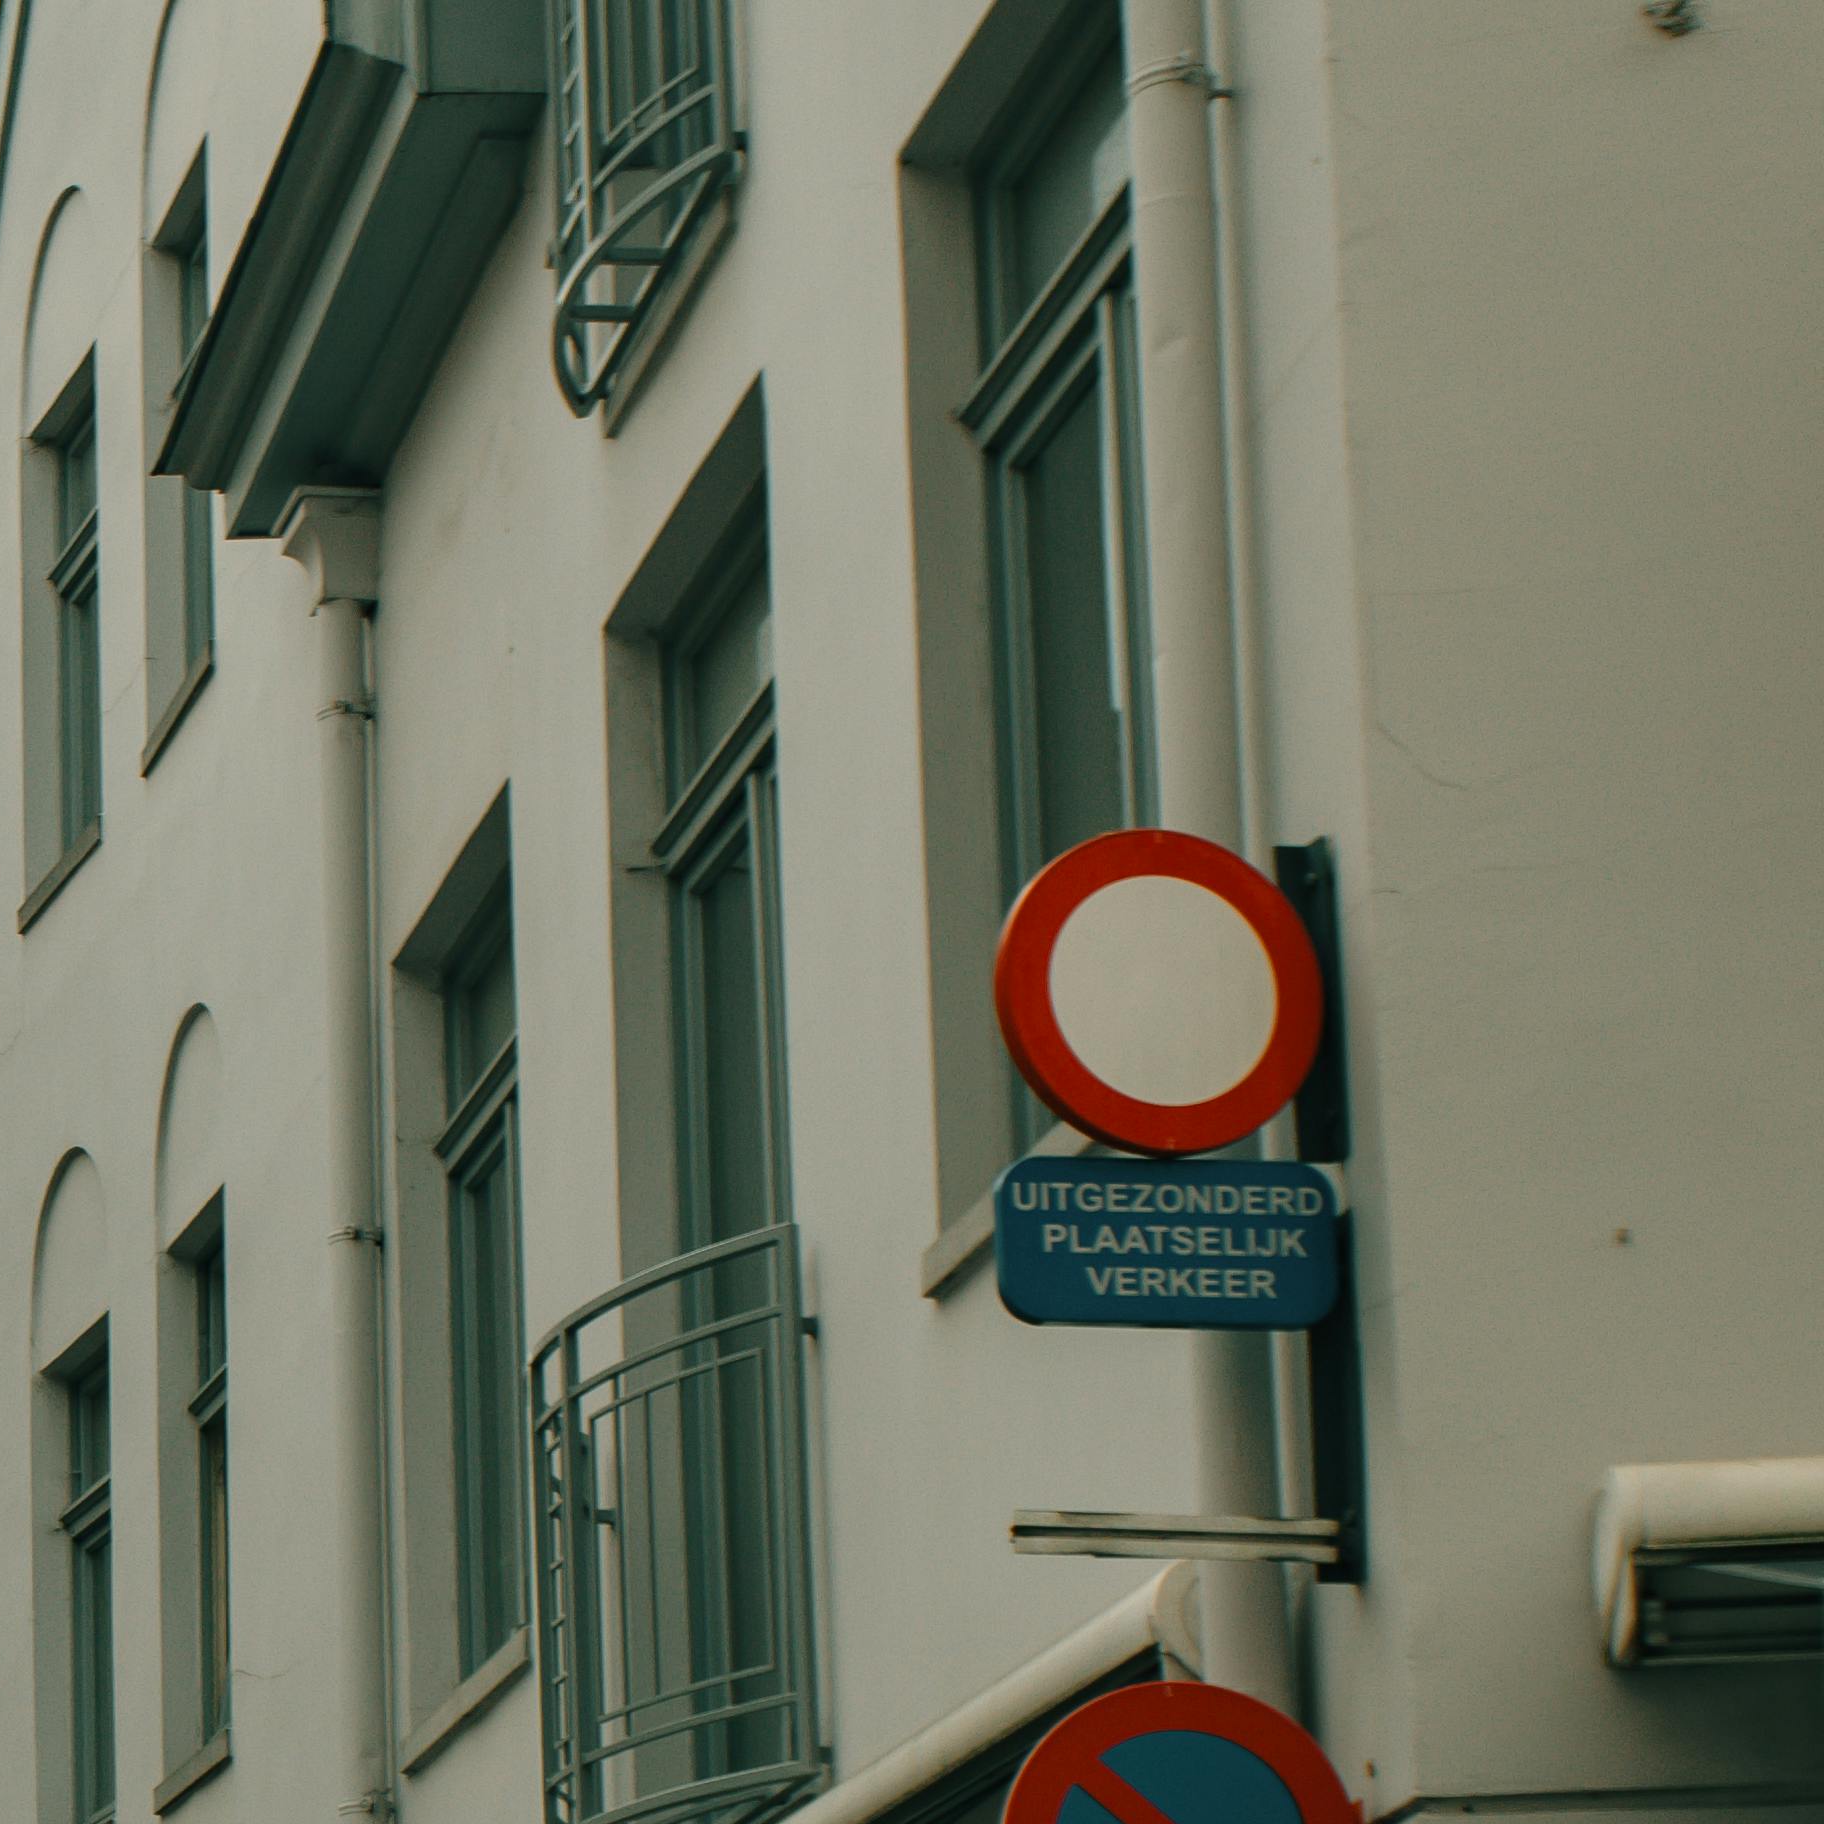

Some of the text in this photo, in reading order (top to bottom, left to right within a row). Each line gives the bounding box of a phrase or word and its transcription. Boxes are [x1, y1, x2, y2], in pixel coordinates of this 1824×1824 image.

[1012, 1182, 1323, 1217] UITGEZONDERD
[1042, 1224, 1308, 1257] PLAATSELIJK
[1087, 1266, 1277, 1299] VERKEER
